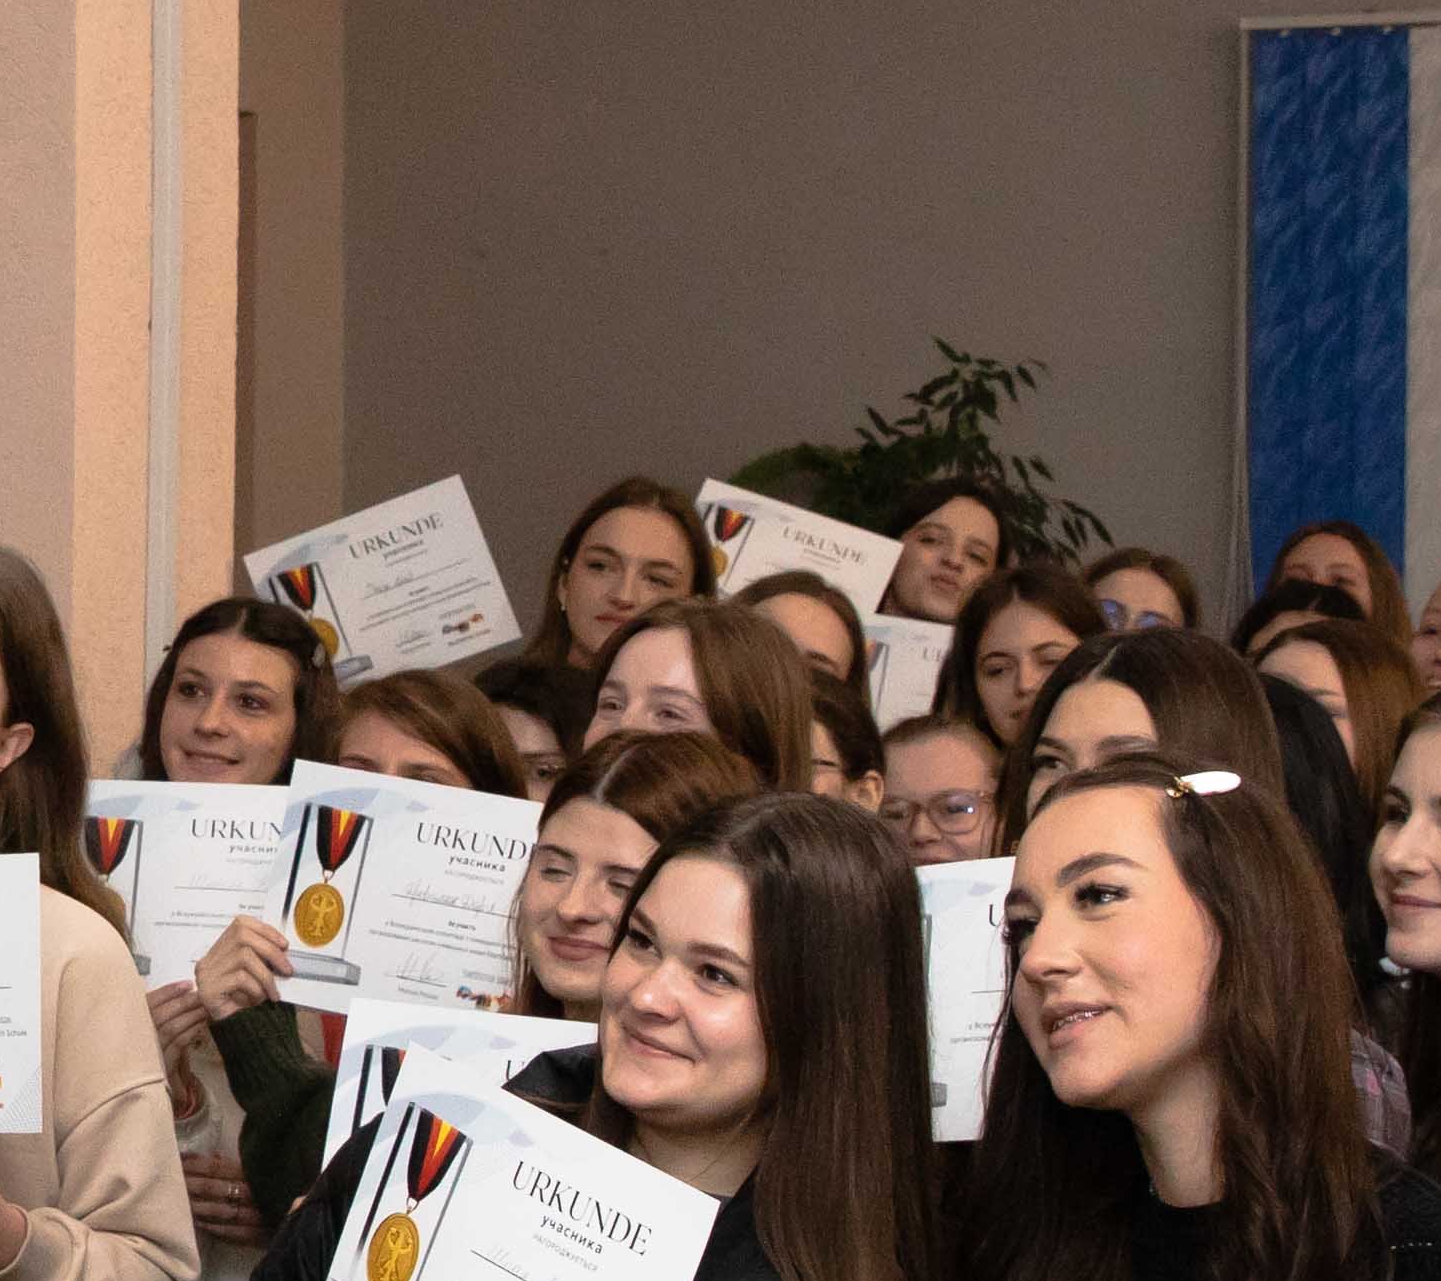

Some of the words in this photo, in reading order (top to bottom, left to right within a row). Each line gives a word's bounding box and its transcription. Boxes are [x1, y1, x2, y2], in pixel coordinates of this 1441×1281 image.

[348, 512, 443, 558] URKUNDE
[191, 819, 282, 841] URKUN
[417, 822, 529, 861] URKUND
[512, 1161, 652, 1255] URKUNDE
[540, 1215, 602, 1254] учасника
